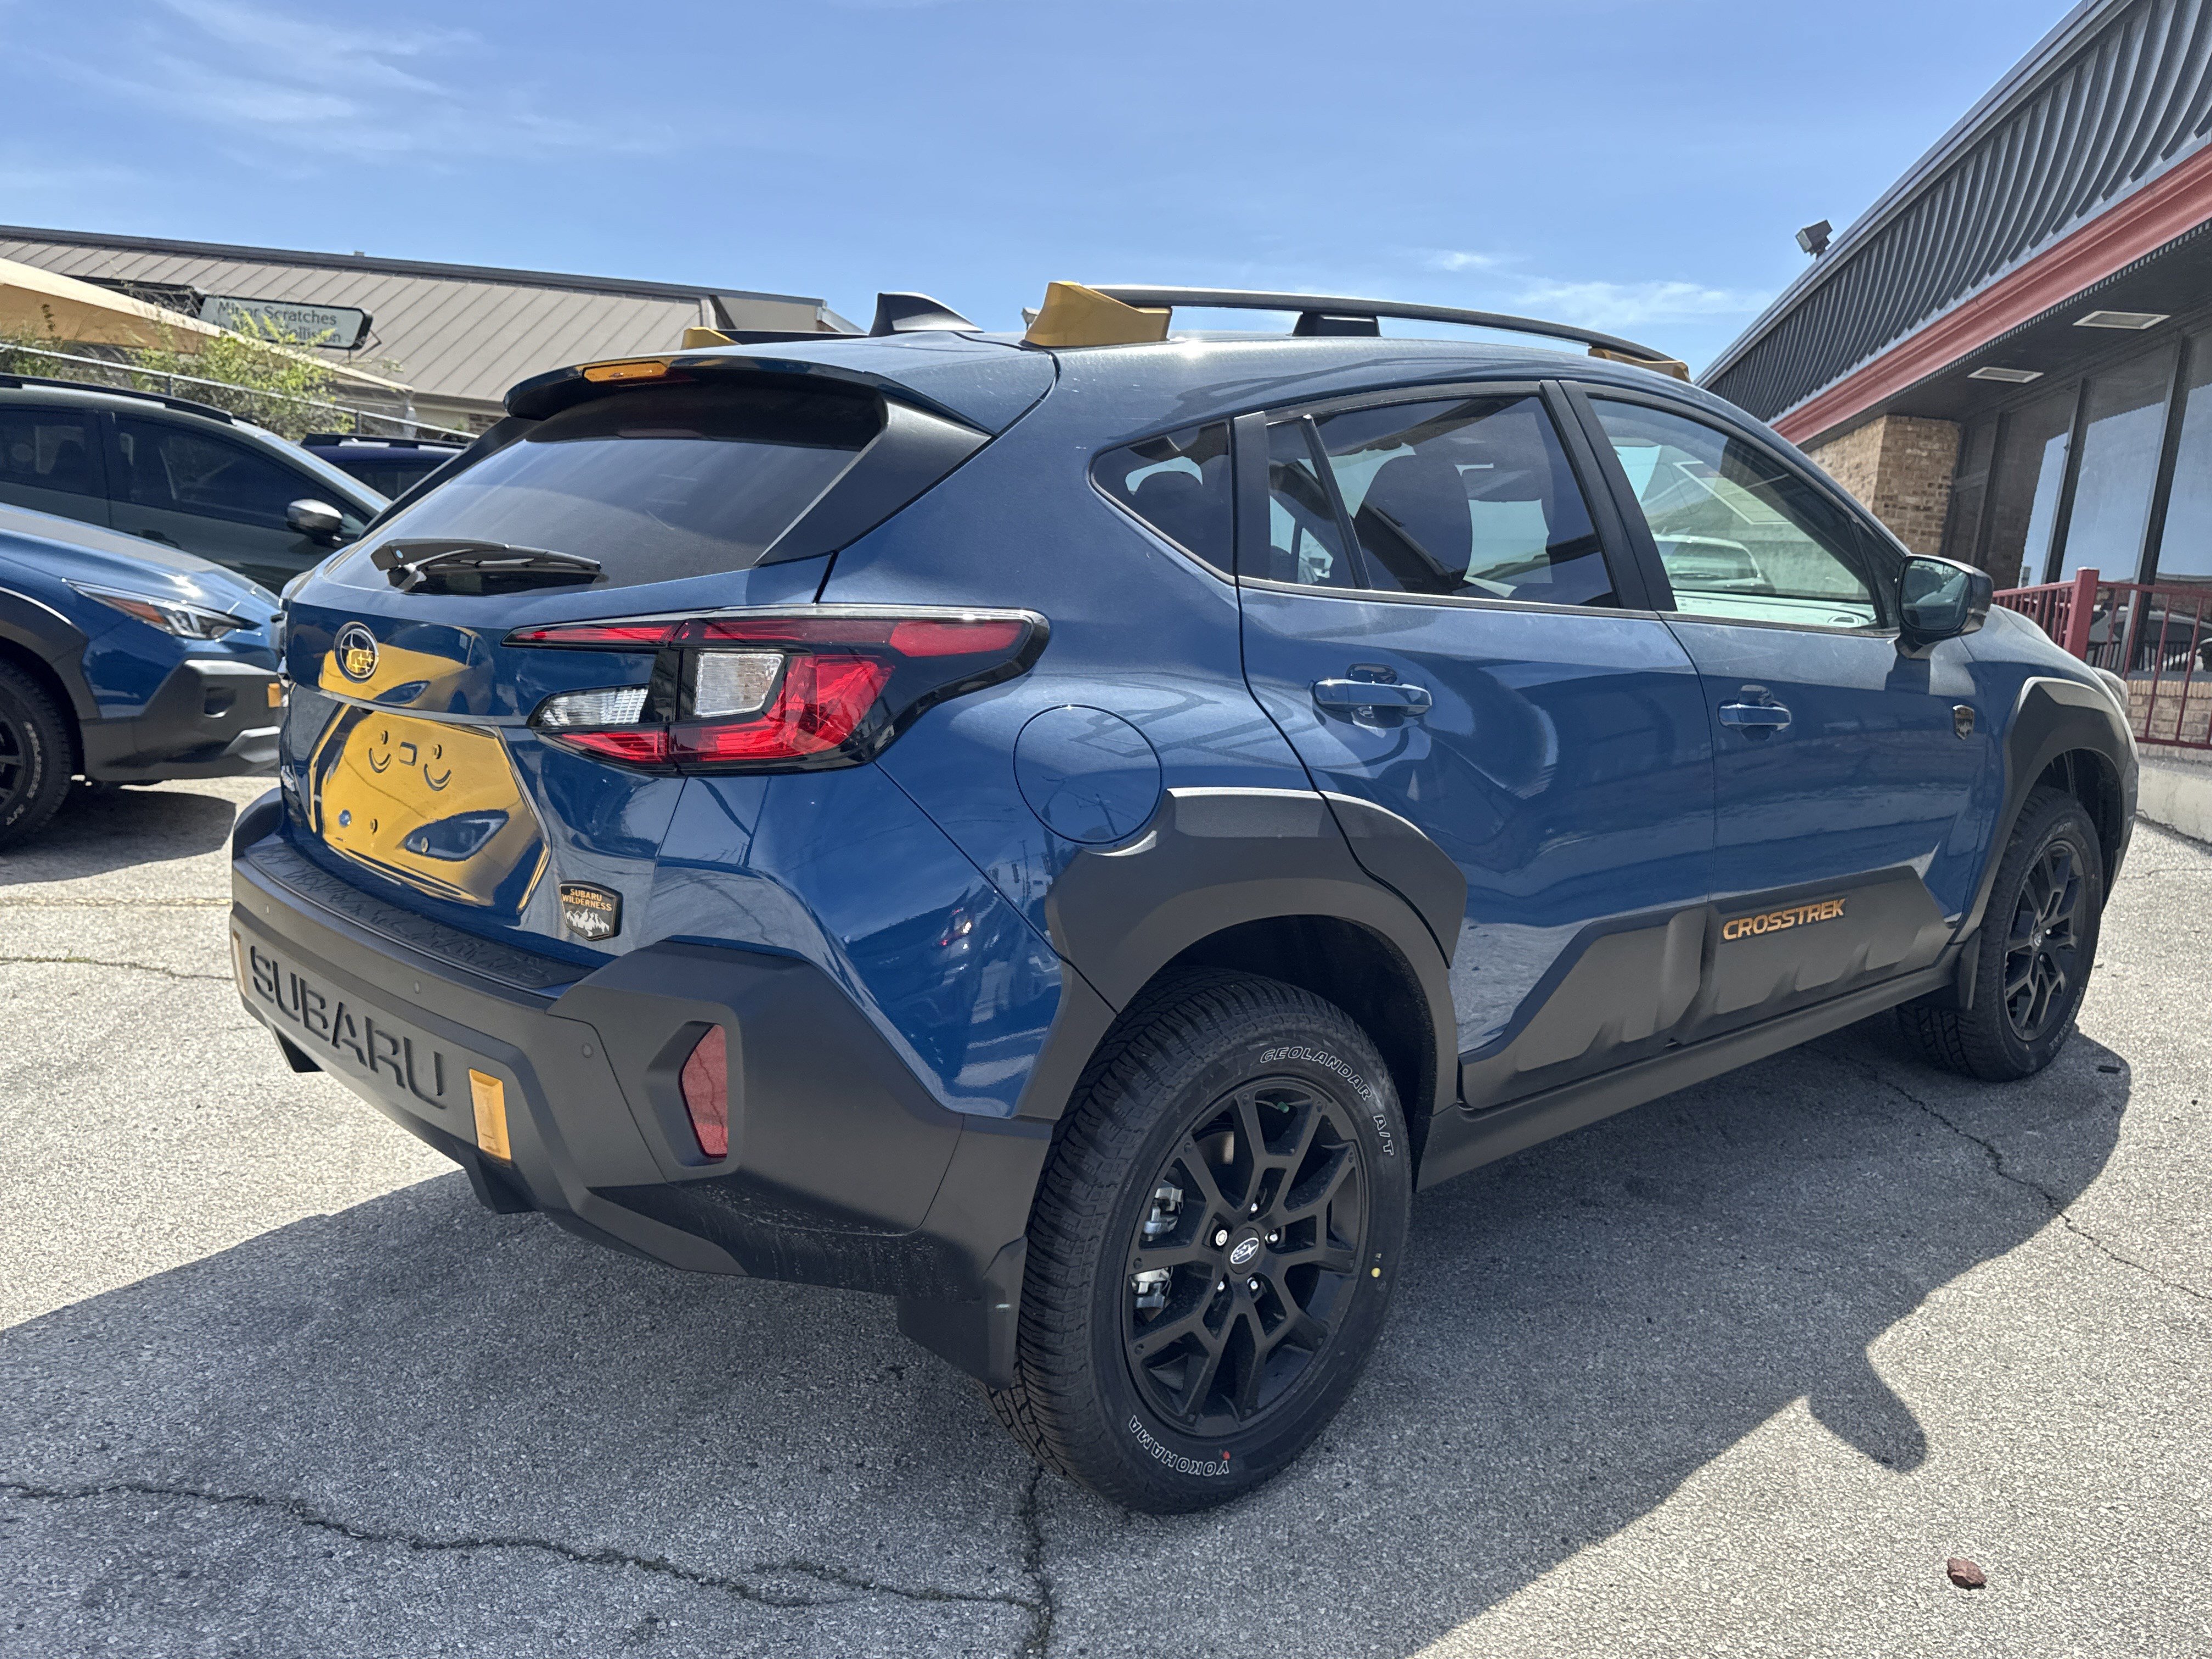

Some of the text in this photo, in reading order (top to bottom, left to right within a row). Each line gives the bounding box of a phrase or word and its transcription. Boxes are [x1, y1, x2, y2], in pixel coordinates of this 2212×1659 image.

[264, 305, 337, 325] Scratches
[562, 894, 612, 911] WILDERNESS
[570, 888, 602, 901] SUBARU
[1723, 898, 1846, 940] CROSSTREK
[250, 945, 447, 1110] SUBARU
[1260, 1046, 1394, 1155] GEOLANDAR A/T
[1128, 1415, 1230, 1476] YOKOHAMA
